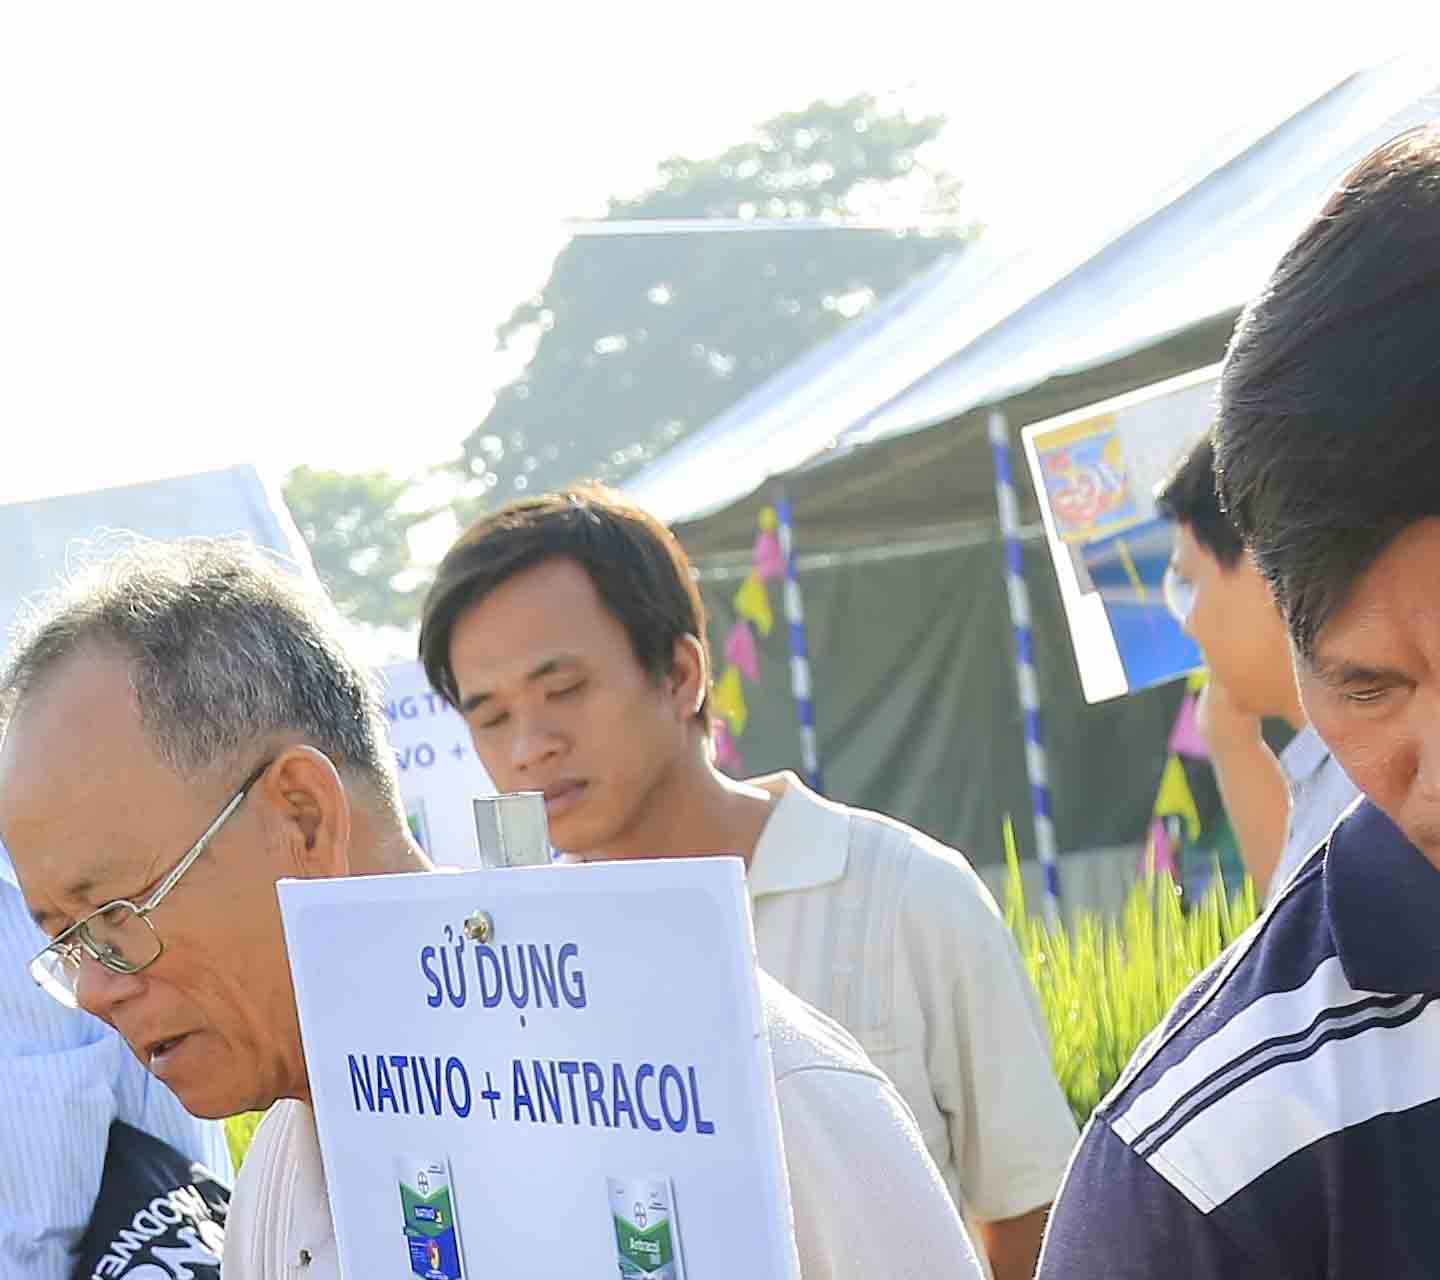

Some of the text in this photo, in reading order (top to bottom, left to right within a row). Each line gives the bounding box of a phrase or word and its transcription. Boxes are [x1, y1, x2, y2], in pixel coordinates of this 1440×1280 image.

[421, 925, 586, 1028] SỬ DỤNG
[347, 1053, 715, 1136] NATIVO + ANTRACOL
